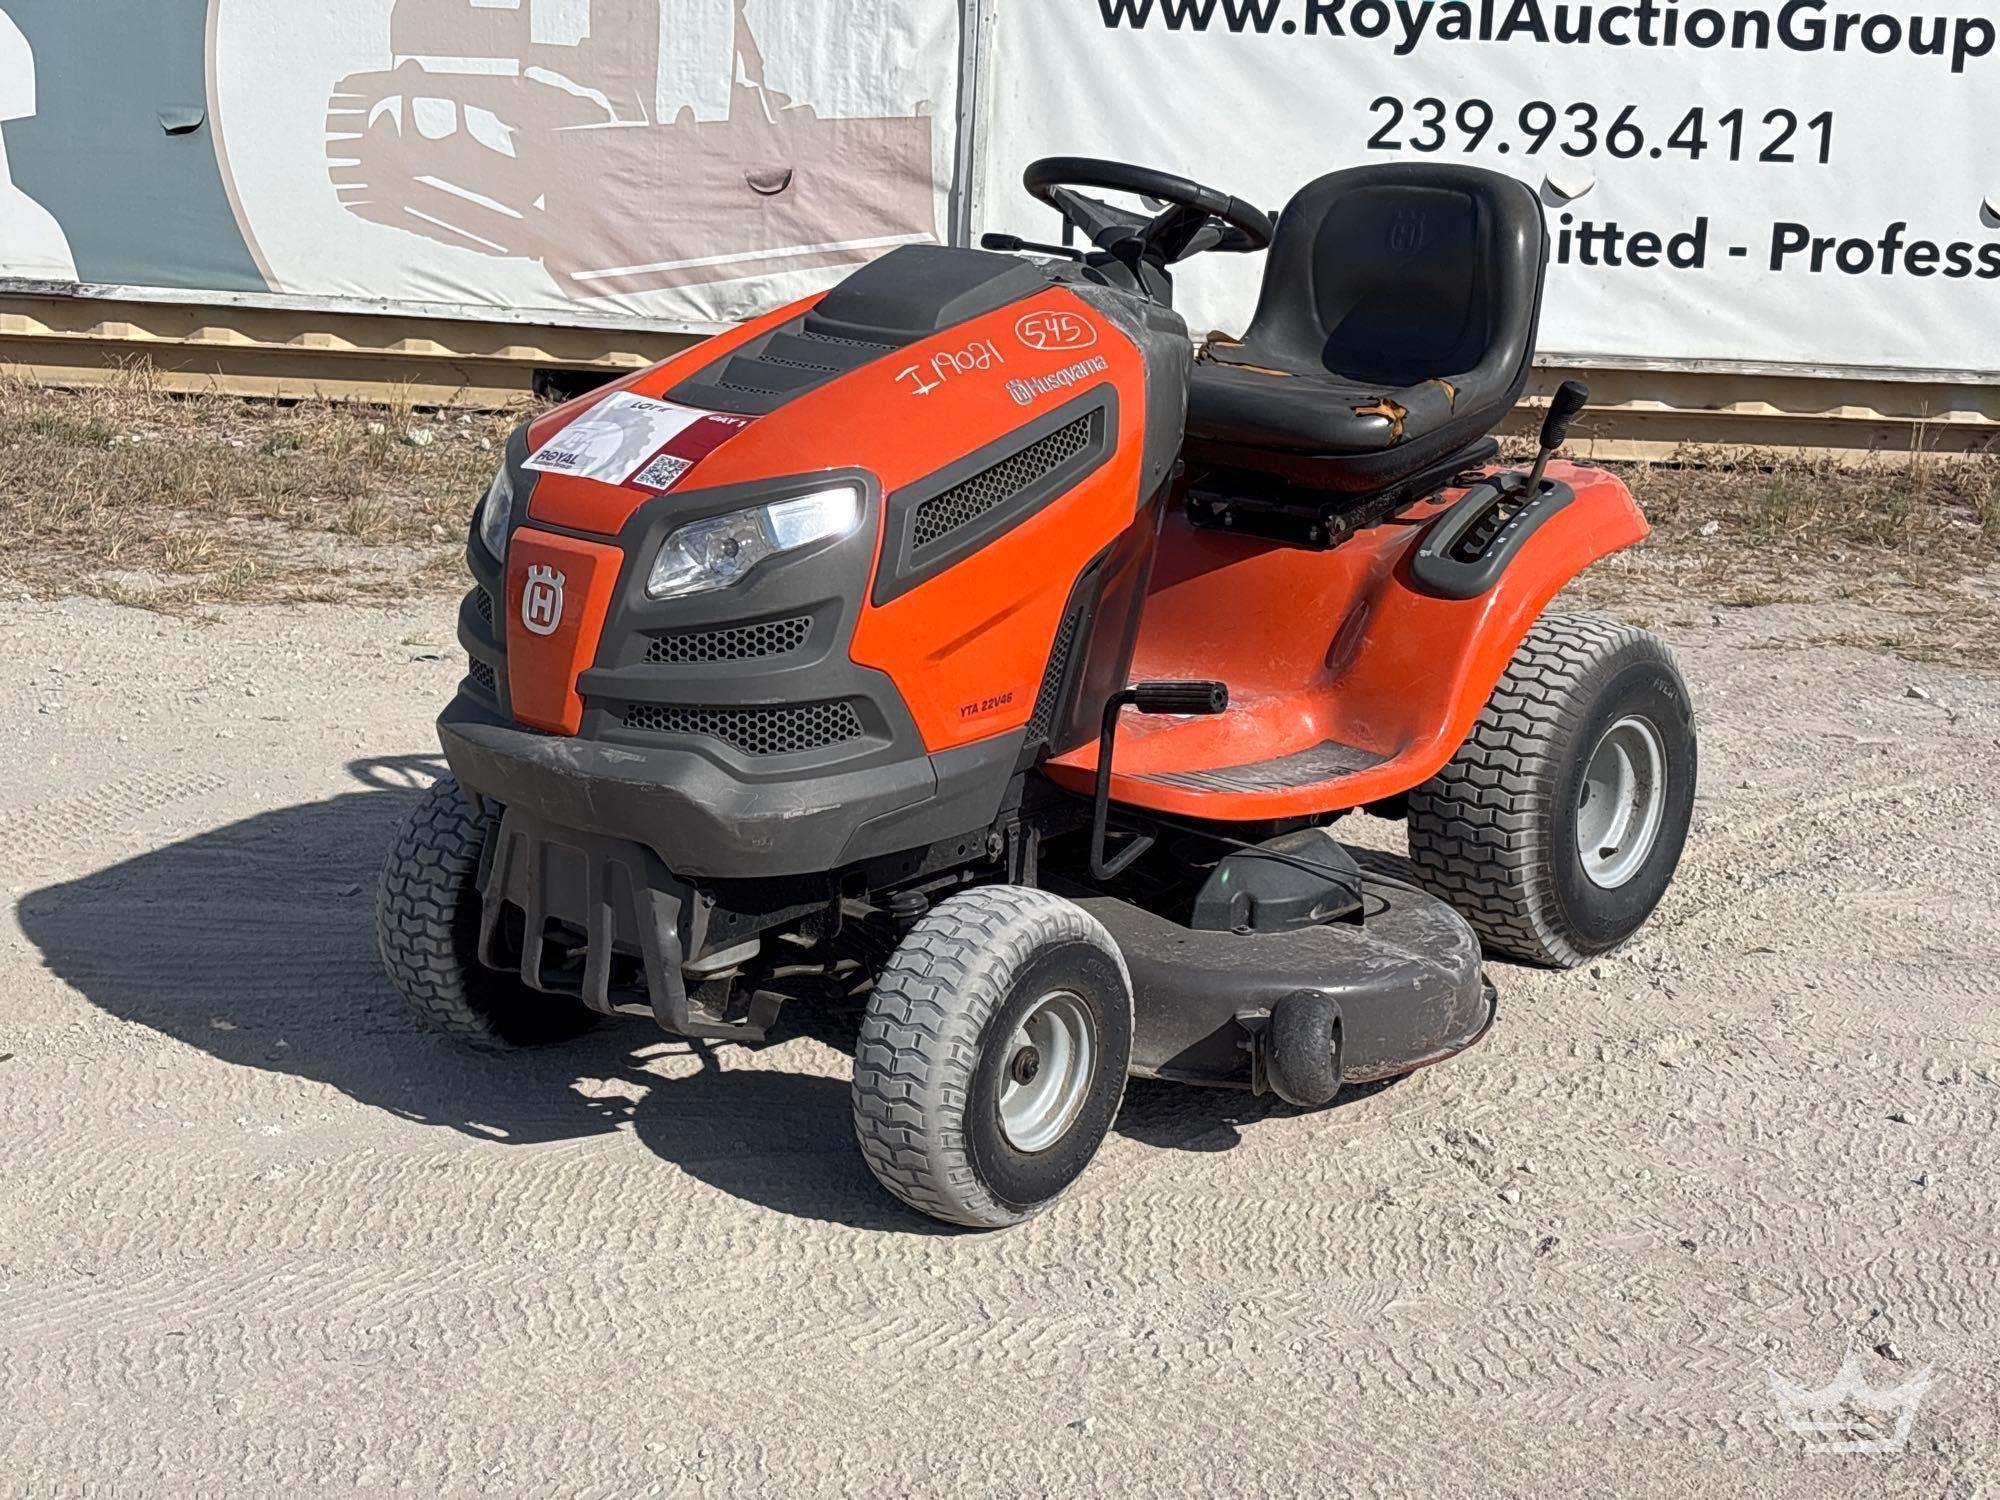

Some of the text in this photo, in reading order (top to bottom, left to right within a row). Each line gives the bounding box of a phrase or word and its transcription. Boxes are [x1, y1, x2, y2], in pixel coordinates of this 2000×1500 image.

[1367, 96, 1833, 164] 239.936.4121
[1769, 221, 2000, 279] Profess
[1024, 317, 1082, 349] 545
[1023, 354, 1109, 398] Husqvarna
[708, 415, 738, 425] DAY
[536, 450, 580, 465] ROYAL
[960, 692, 1013, 718] YTA 22V46
